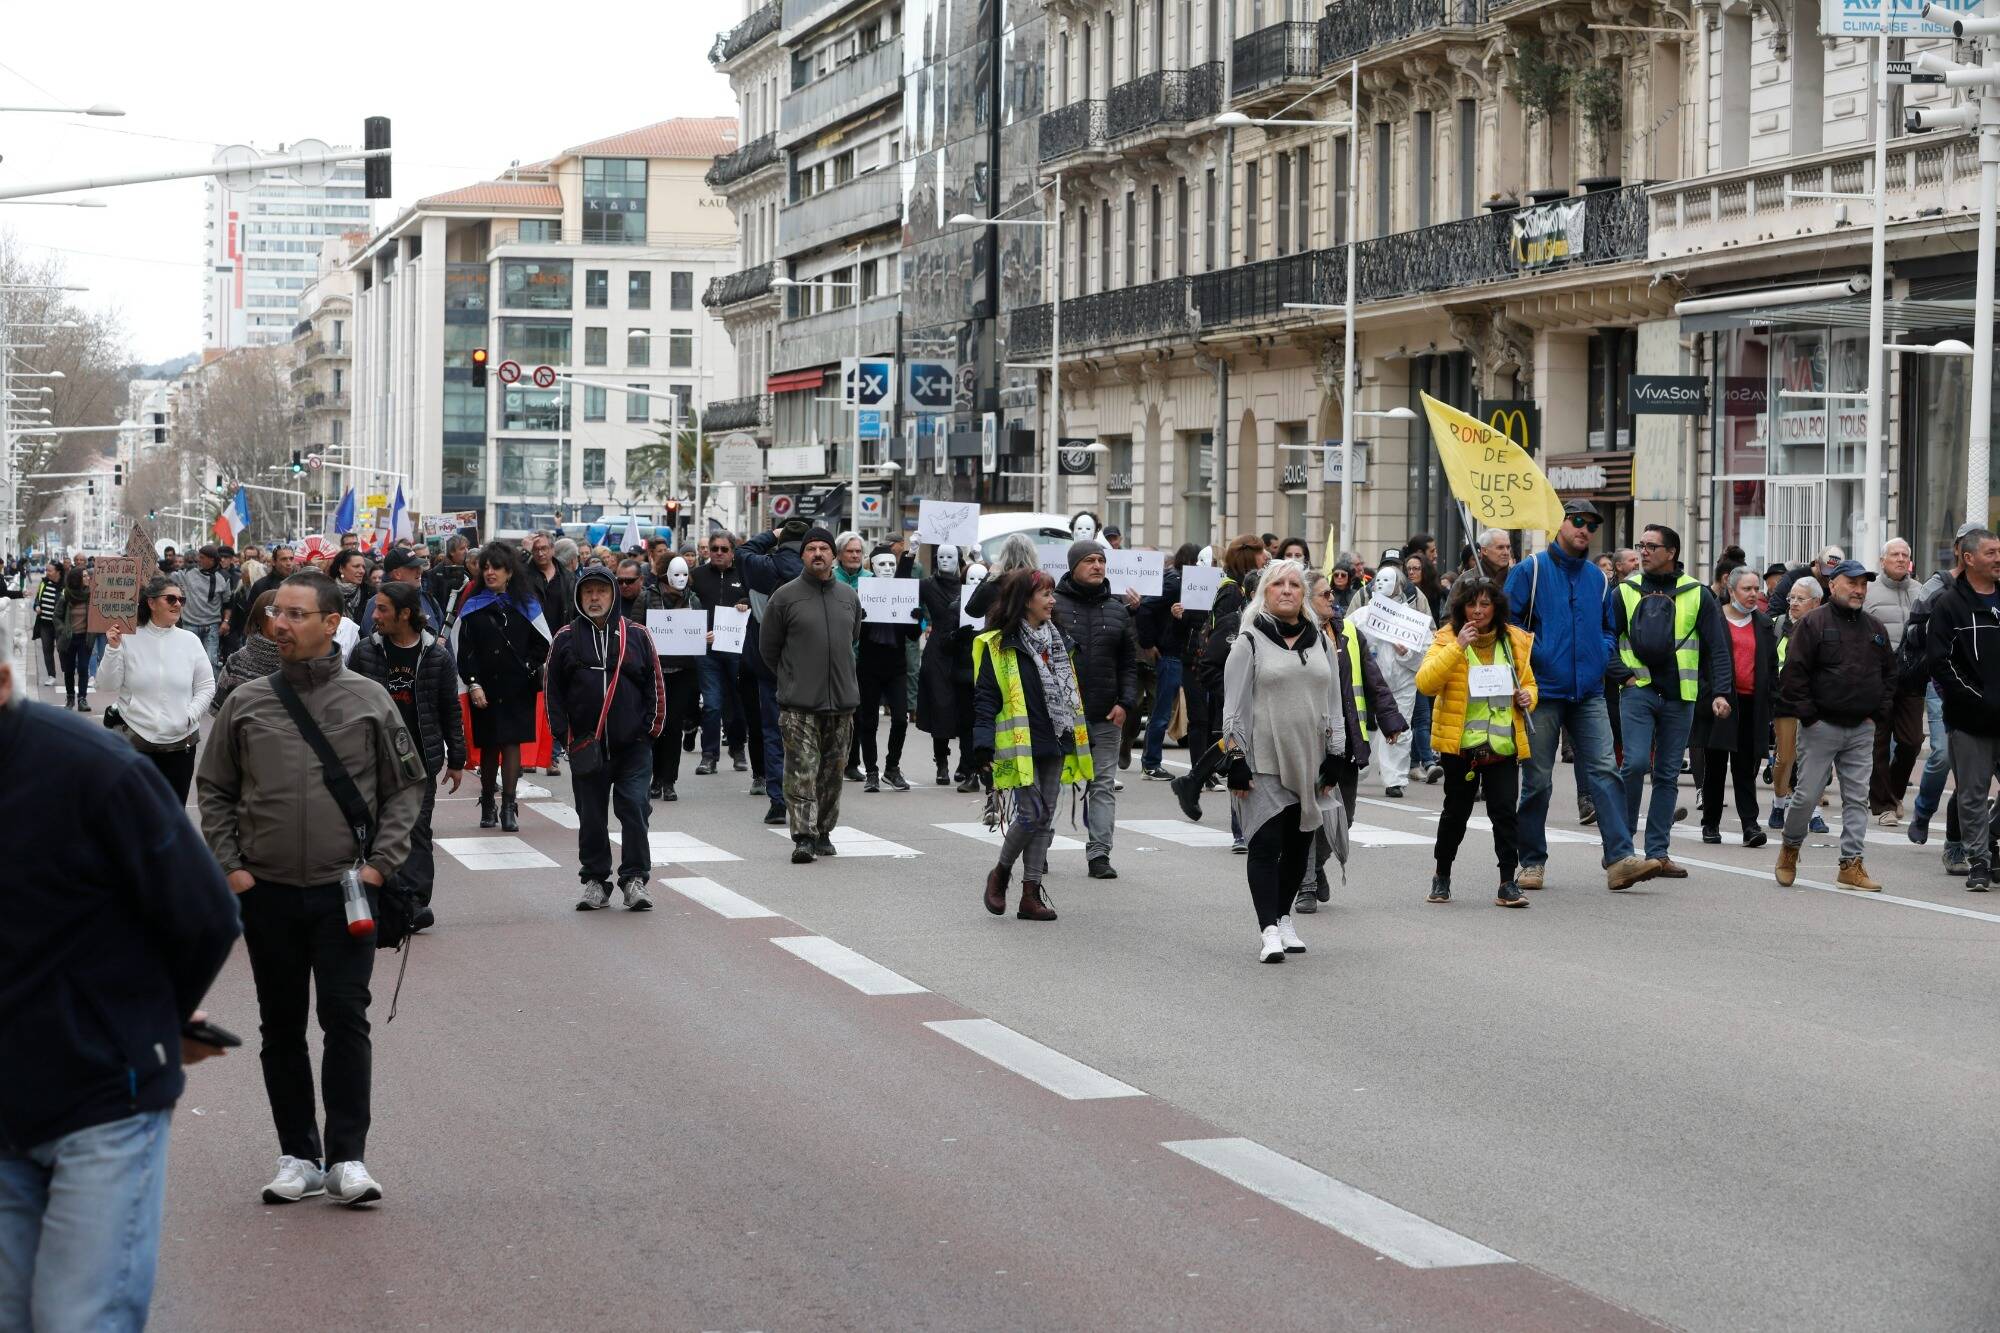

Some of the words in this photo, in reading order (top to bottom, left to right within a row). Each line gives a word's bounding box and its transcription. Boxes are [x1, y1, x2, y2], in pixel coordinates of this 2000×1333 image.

[1843, 21, 1908, 32] CLIMAISE
[1887, 64, 1911, 73] ANAL
[1450, 422, 1510, 446] ROND-
[1484, 447, 1508, 463] DE
[1470, 470, 1533, 492] CUERS
[1481, 494, 1514, 518] 83
[1106, 567, 1124, 575] tous
[1126, 566, 1138, 576] les
[1139, 568, 1160, 577] jours
[1187, 583, 1197, 591] de
[650, 626, 674, 635] Mieux
[683, 626, 702, 635] vaut
[1372, 618, 1423, 642] TOULON
